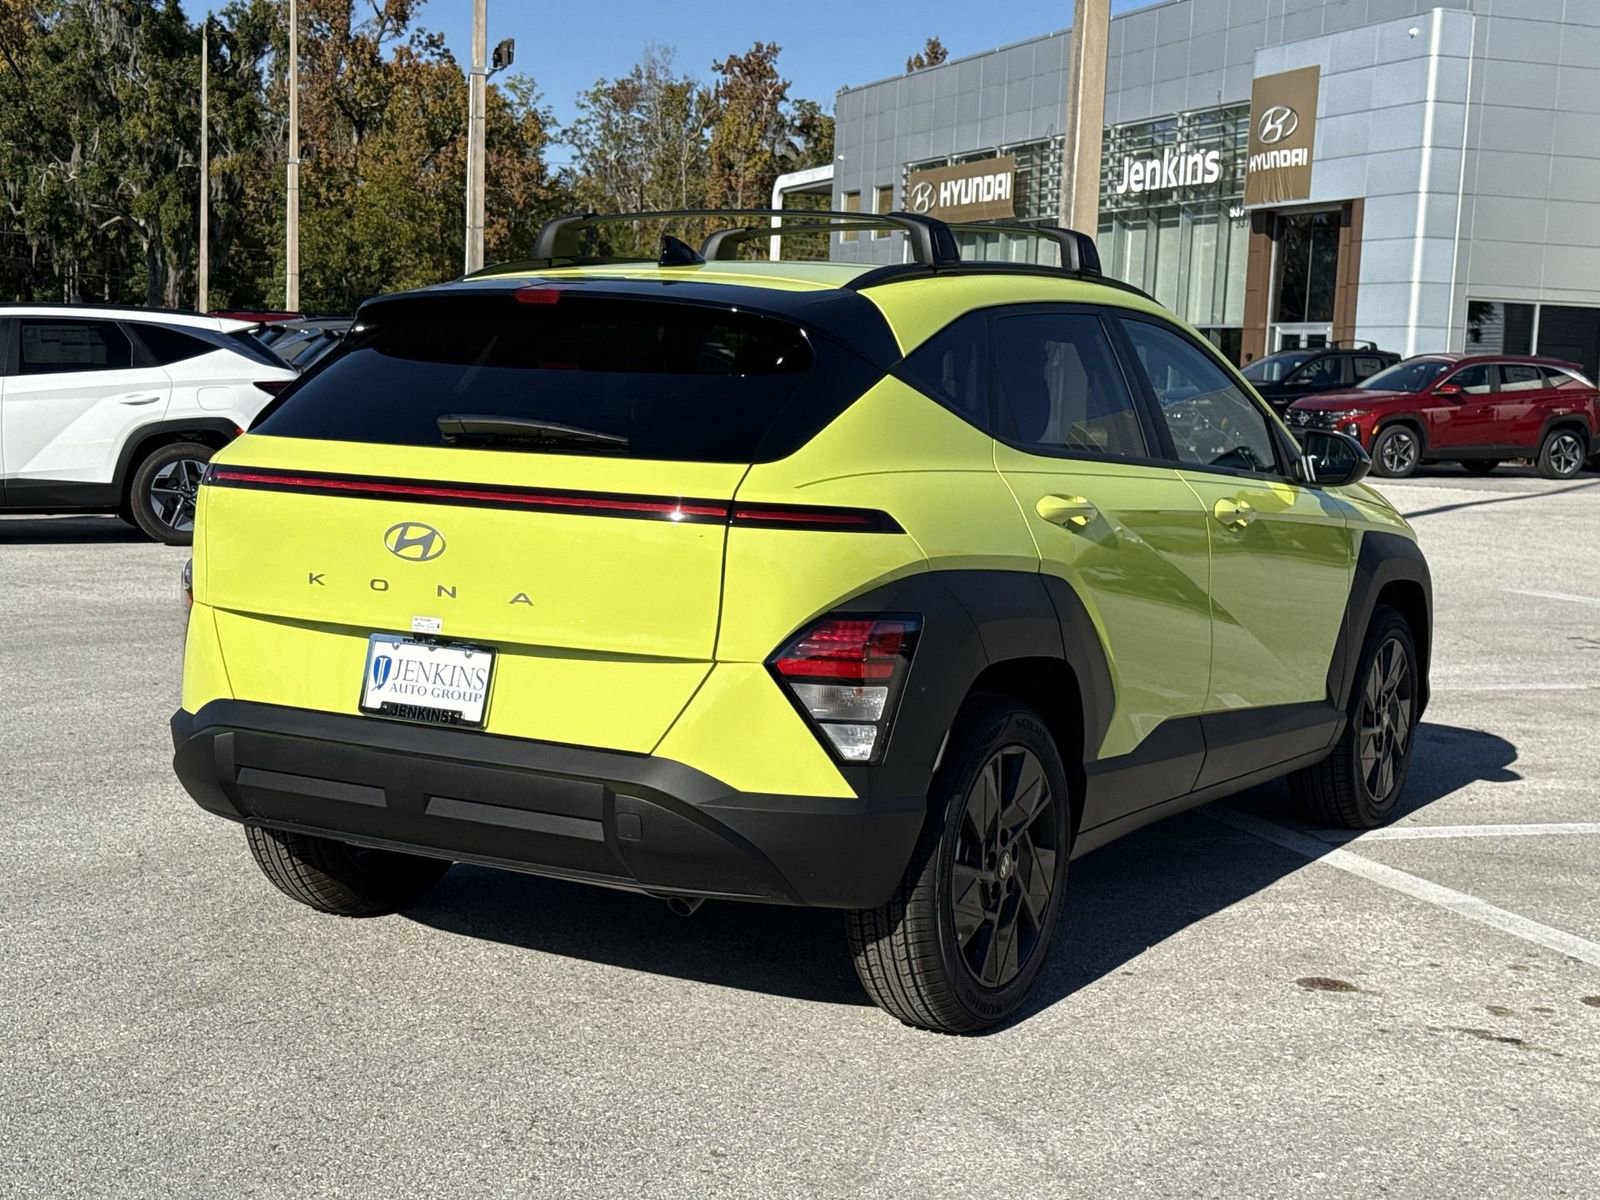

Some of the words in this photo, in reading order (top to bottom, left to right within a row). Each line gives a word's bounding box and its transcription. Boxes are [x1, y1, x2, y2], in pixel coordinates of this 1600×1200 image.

[1117, 144, 1221, 194] Jenkins
[1249, 147, 1308, 172] HYUNDAI
[939, 171, 1011, 208] HYUNDAI
[308, 572, 534, 606] KONA
[392, 658, 487, 692] JENKINS
[389, 682, 427, 697] AUTO
[431, 687, 483, 703] GROUP
[391, 705, 449, 723] JENKINS
